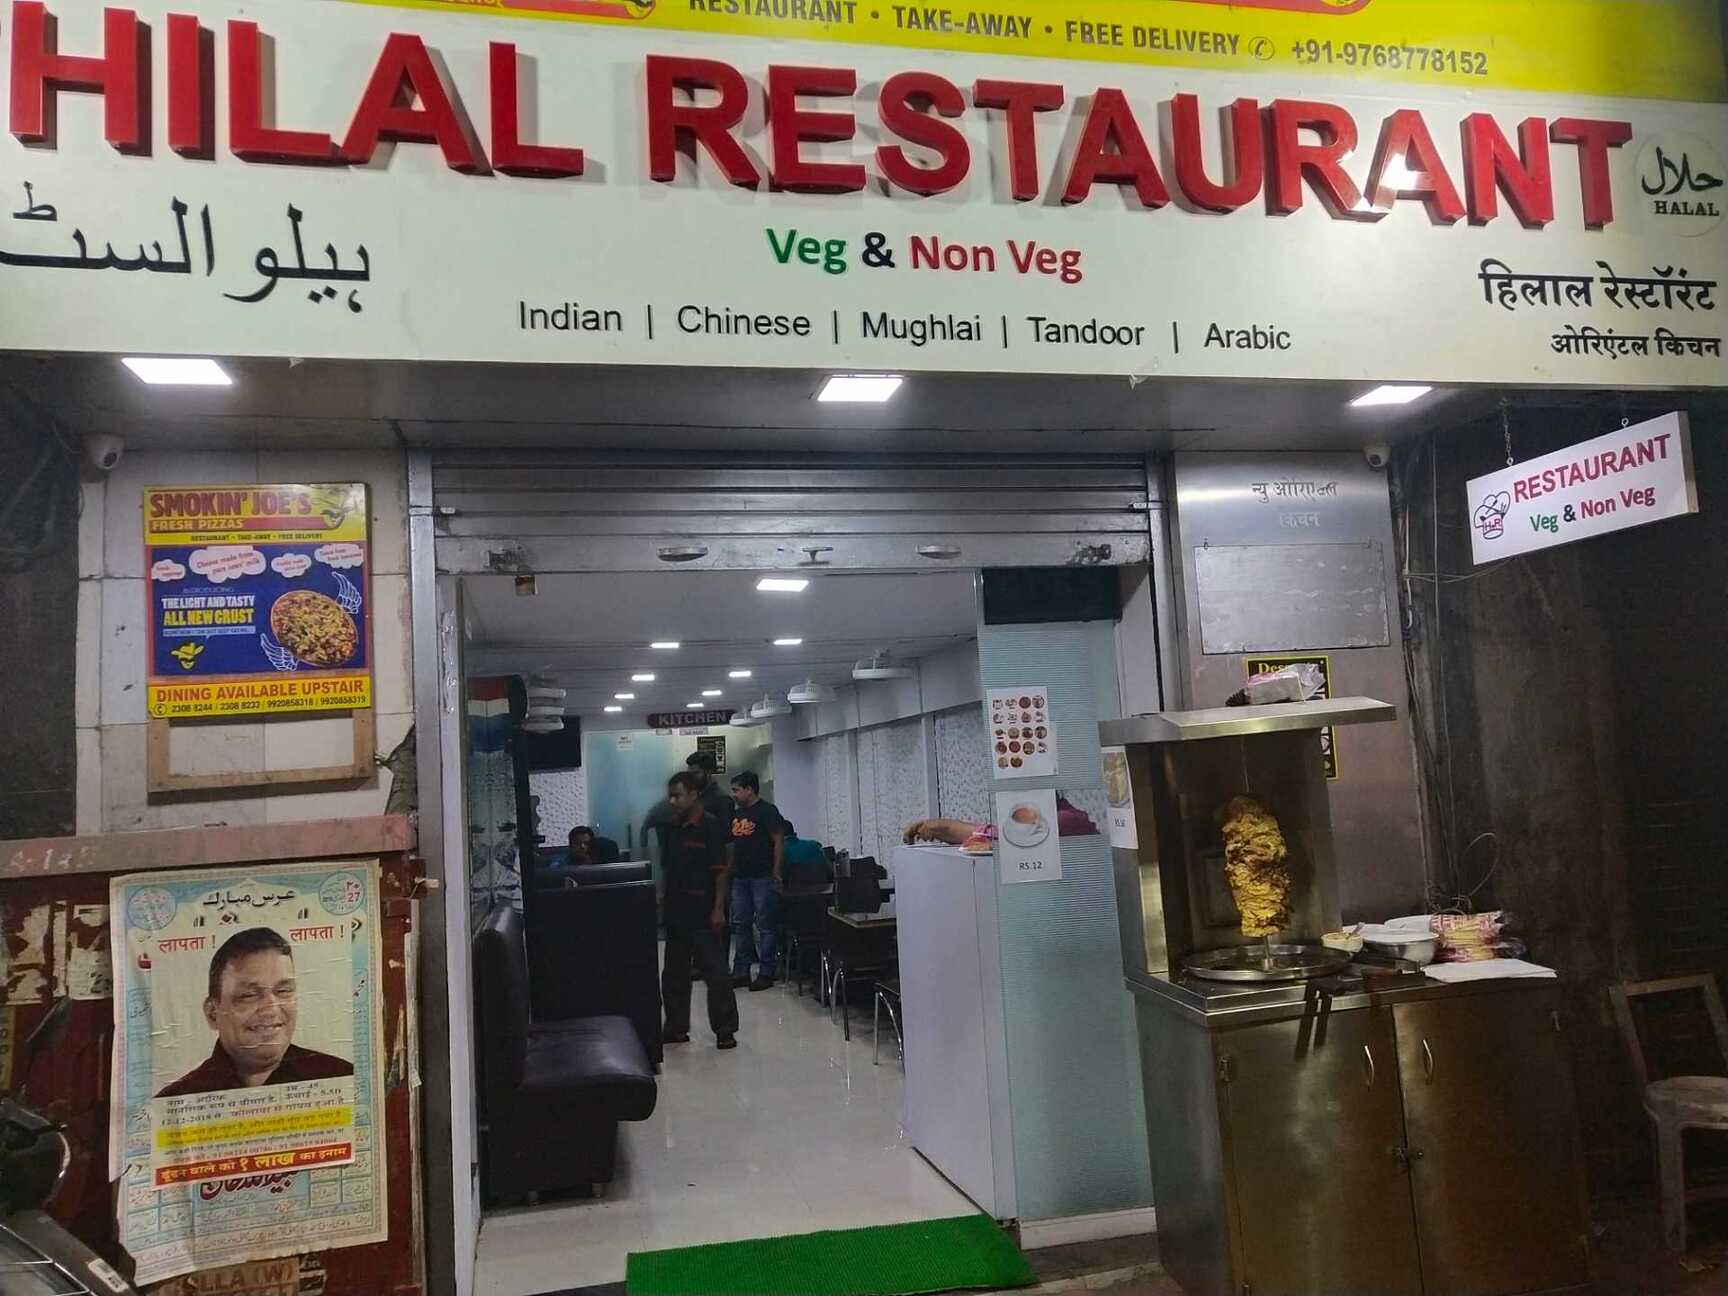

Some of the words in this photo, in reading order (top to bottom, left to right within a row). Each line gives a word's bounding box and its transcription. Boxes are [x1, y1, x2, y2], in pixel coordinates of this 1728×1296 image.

[688, 0, 857, 24] RESTAURANT
[891, 5, 1033, 39] TAKE-AWAY
[1064, 20, 1124, 48] FREE
[1132, 25, 1240, 56] DELIVERY
[1291, 39, 1488, 76] +91-9768778152
[9, 1, 584, 177] HILAL
[645, 54, 1632, 231] RESTAURANT
[1654, 200, 1720, 216] HALAL
[766, 228, 847, 274] Veg
[861, 231, 895, 268] &
[909, 235, 995, 273] Non
[1007, 239, 1082, 284] Veg
[1478, 258, 1594, 311] हिलाल
[1595, 260, 1717, 311] रेस्टॉरंट
[519, 301, 623, 331] Indian
[677, 304, 811, 336] Chinese
[862, 311, 982, 346] Mughlai
[1026, 316, 1145, 345] Tandoor
[1203, 322, 1291, 350] Arabic
[1551, 324, 1650, 359] ओरिएंटल
[1653, 327, 1722, 357] किचन
[1513, 433, 1672, 503] RESTAURANT
[150, 492, 248, 517] SMOKIN'
[1529, 514, 1559, 533] Veg
[1563, 504, 1577, 523] &
[1580, 497, 1616, 519] Non
[1620, 486, 1656, 507] Veg
[151, 520, 194, 530] FRESH
[198, 519, 246, 530] PIZZAS
[161, 597, 179, 609] THE
[179, 597, 207, 609] LIGHT
[206, 596, 226, 608] AND
[225, 595, 255, 608] TASTY
[163, 610, 187, 626] ALL
[187, 609, 213, 625] NEW
[214, 608, 255, 624] CRUST
[156, 687, 211, 702] DINING
[216, 682, 297, 700] AVAILABLE
[302, 679, 363, 696] UPSTAIR
[657, 711, 727, 726] KITCHEN
[159, 935, 207, 955] लापता
[288, 925, 335, 942] लापता
[254, 1152, 297, 1169] लाख
